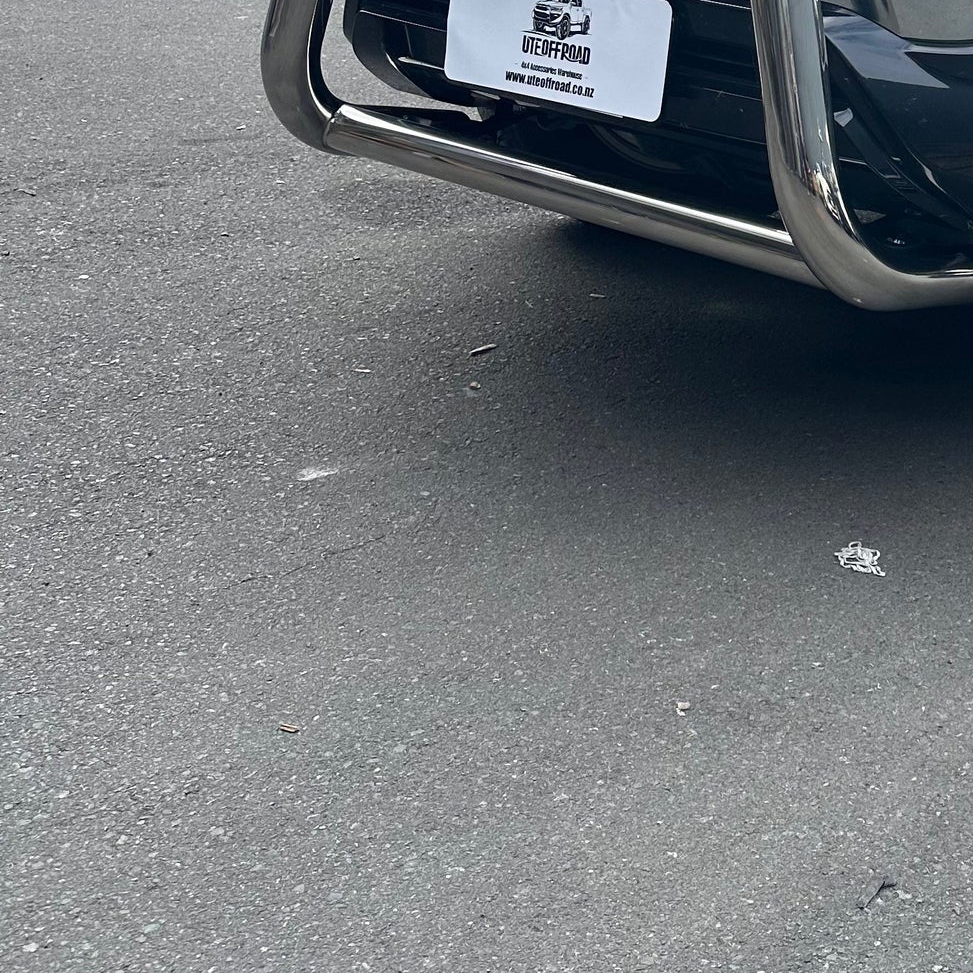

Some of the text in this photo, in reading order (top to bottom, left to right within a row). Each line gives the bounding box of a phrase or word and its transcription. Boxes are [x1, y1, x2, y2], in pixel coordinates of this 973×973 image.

[530, 63, 556, 75] Accessories
[557, 68, 583, 80] Warehouse
[505, 70, 595, 98] www.uteoffroad.co.nz
